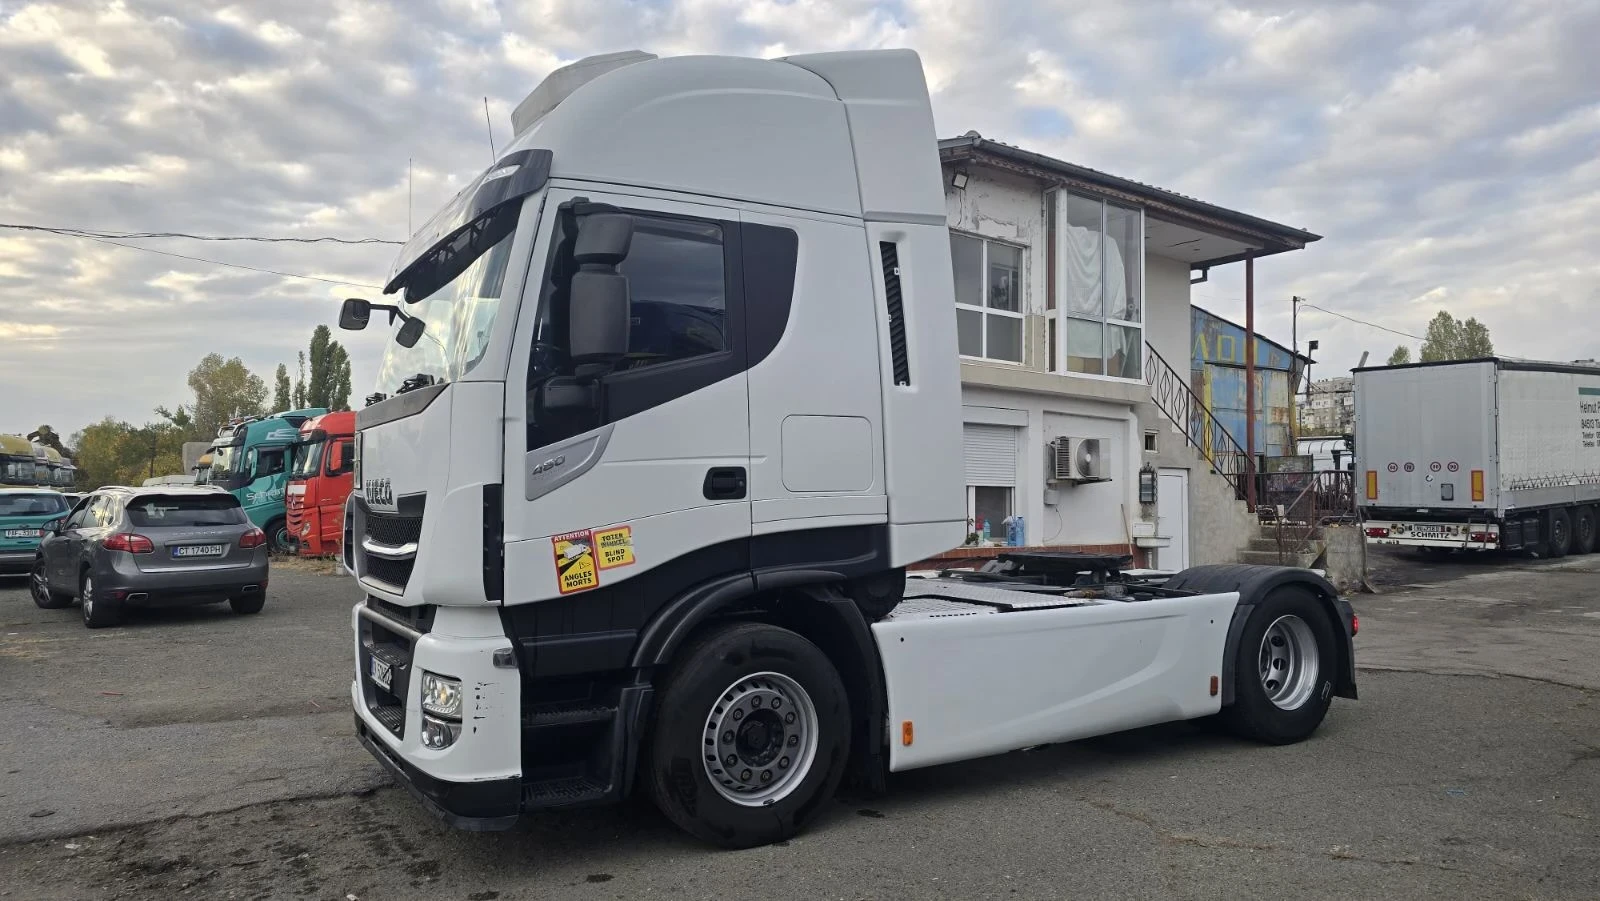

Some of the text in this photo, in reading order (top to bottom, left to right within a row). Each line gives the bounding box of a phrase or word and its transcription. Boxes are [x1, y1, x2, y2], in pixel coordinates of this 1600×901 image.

[366, 478, 393, 505] IVECO
[554, 530, 590, 542] ATTENTION
[601, 532, 624, 542] TOTER
[1410, 531, 1450, 539] SCHMITZ
[179, 547, 189, 555] CT
[191, 546, 210, 554] 1740
[604, 548, 625, 558] BLIND
[607, 554, 625, 564] SPOT
[564, 570, 592, 582] ANGLES
[566, 577, 592, 589] MORTS
